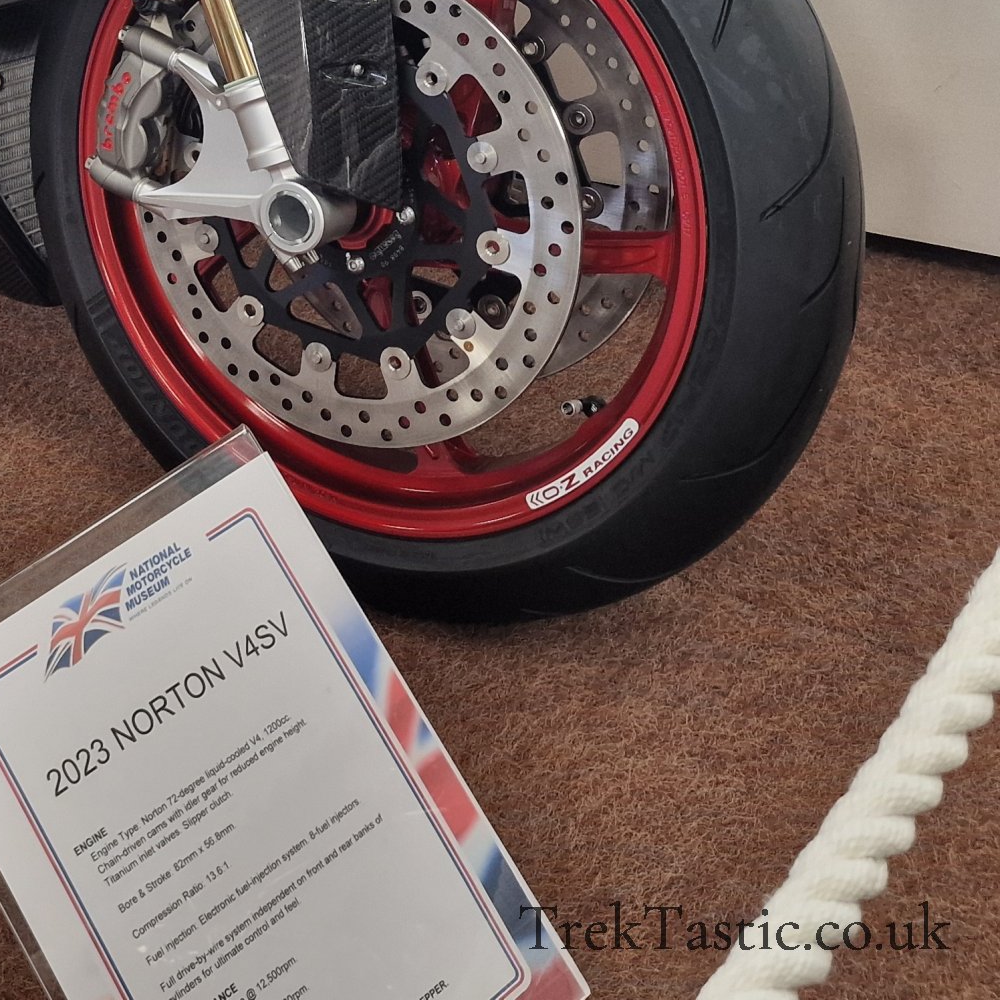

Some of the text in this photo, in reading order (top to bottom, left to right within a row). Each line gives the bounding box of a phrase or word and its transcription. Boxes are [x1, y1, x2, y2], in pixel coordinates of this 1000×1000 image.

[102, 72, 132, 151] brembo
[583, 428, 634, 478] RACING
[124, 575, 171, 612] MUSEUM
[125, 547, 192, 597] MOTORCYCLE
[129, 542, 182, 581] NATIONAL
[46, 610, 289, 798] 2023 NORTON V4SV
[90, 838, 119, 863] Engine
[140, 802, 168, 826] Norton
[166, 775, 206, 806] 72-degree
[204, 741, 251, 780] liquid-cooled
[248, 733, 265, 746] V4,
[97, 836, 147, 875] Chain-driven
[146, 820, 168, 839] cams
[167, 808, 185, 824] with
[183, 795, 201, 812] idler
[200, 782, 219, 802] gear
[217, 774, 230, 787] for
[229, 751, 260, 779] reduced
[259, 735, 284, 757] engine
[73, 826, 109, 857] ENGINE
[103, 859, 139, 887] Titanium
[137, 845, 157, 863] inlet
[181, 806, 209, 830] Slipper
[117, 895, 139, 914] Bore
[137, 888, 147, 899] &
[172, 850, 199, 872] 82mm
[197, 845, 205, 854] x
[145, 946, 165, 966] Fuel
[197, 893, 237, 926] Electronic
[234, 858, 282, 897] fuel-injection
[308, 818, 331, 841] 8-fuel
[159, 812, 384, 993] Full drive-by-wire system independent on front and rear banks of
[131, 898, 183, 940] Compression
[201, 965, 214, 979] for
[213, 942, 245, 970] ultimate
[244, 919, 270, 946] control
[269, 908, 285, 926] and
